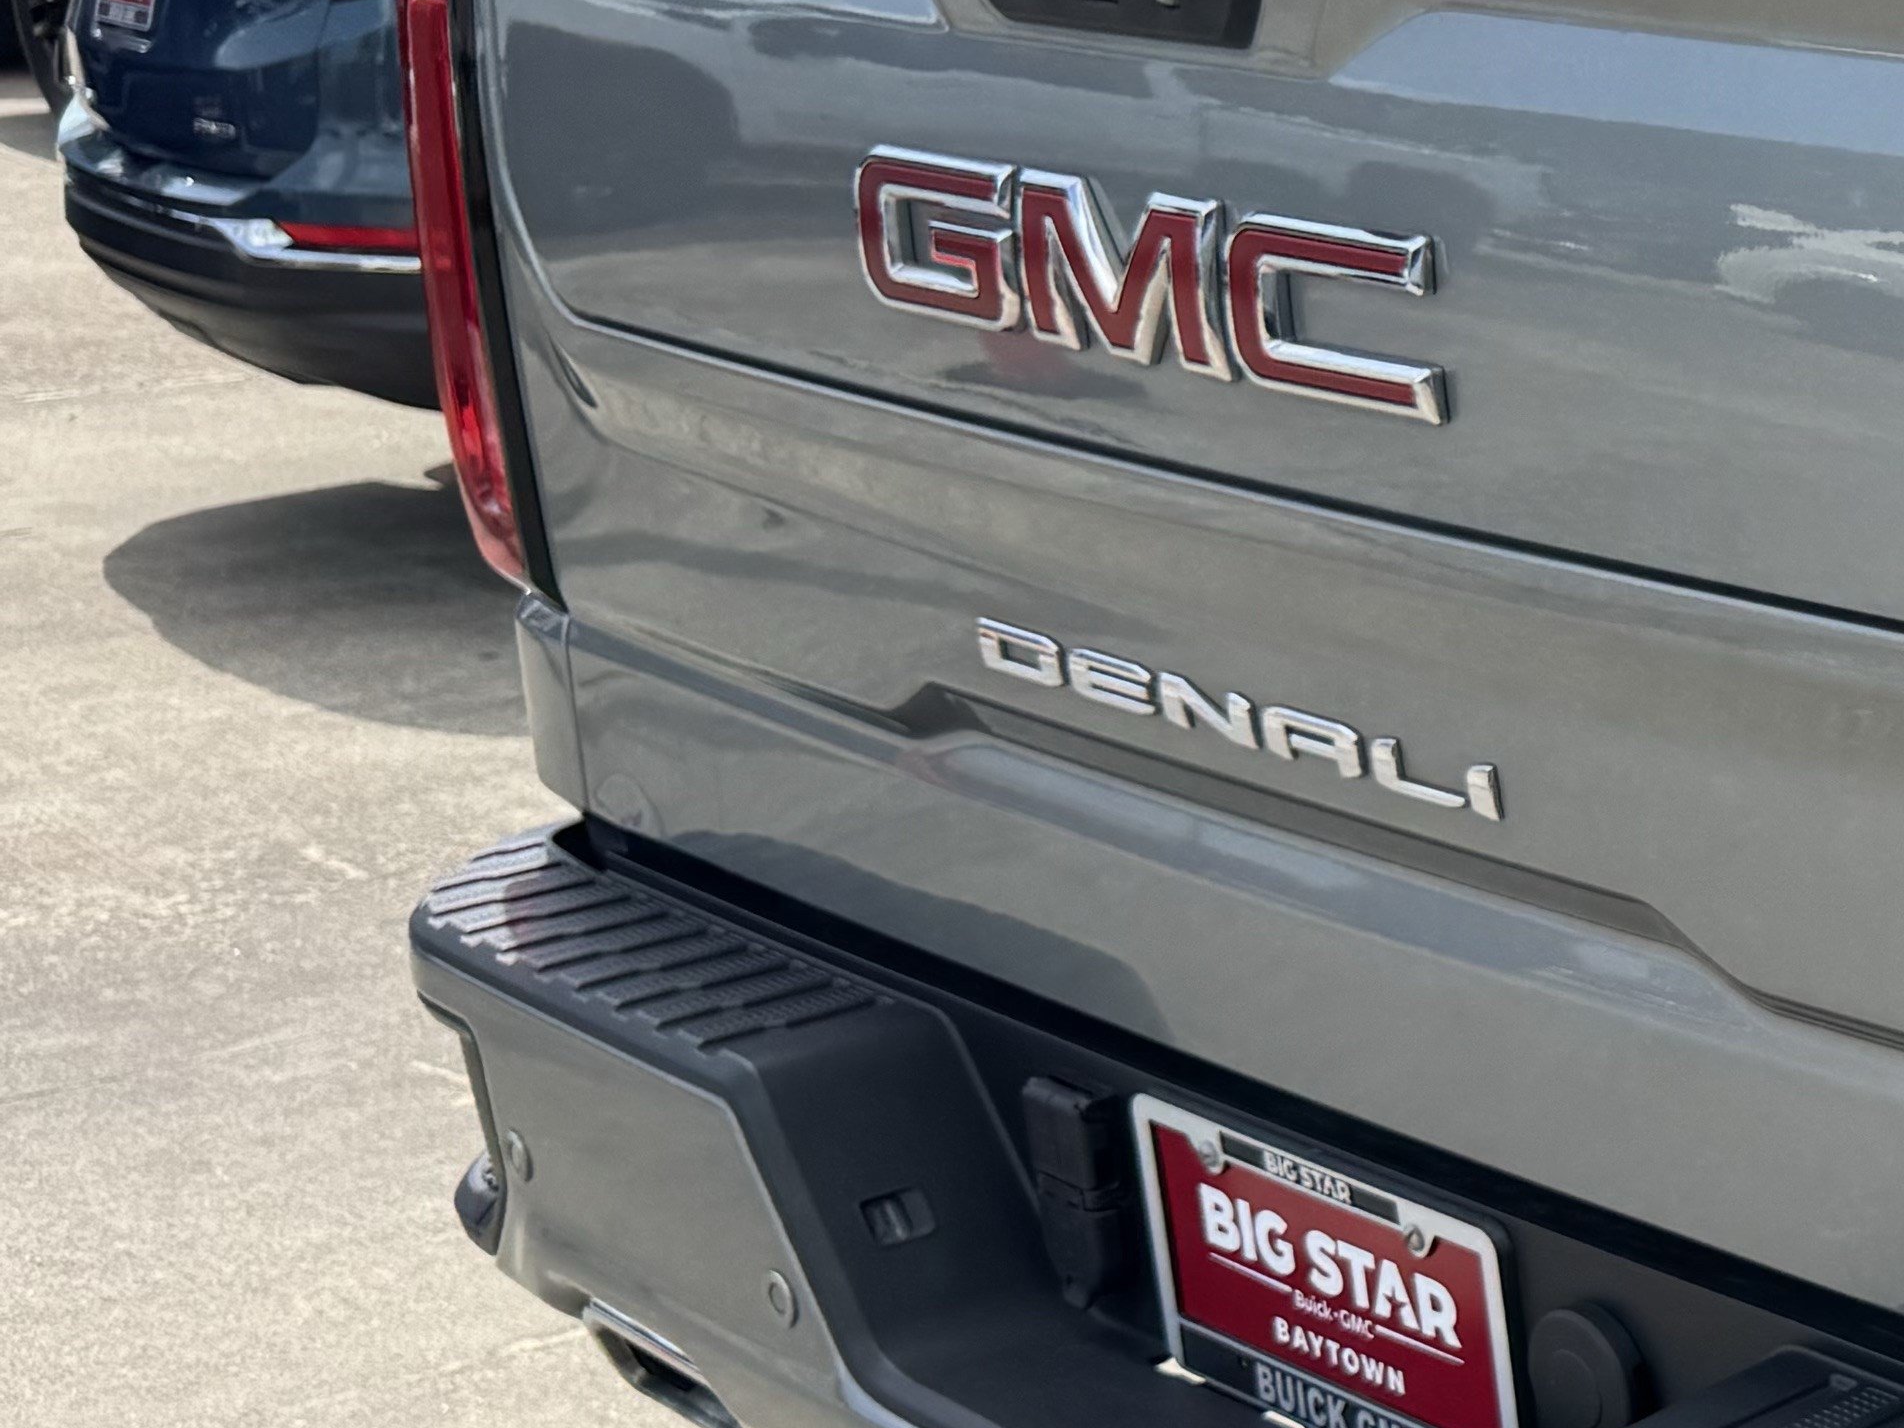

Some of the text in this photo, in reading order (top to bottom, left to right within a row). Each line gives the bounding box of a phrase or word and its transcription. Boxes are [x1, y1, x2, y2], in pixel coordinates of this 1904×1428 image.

[855, 143, 1451, 426] GMC
[977, 615, 1505, 822] DENALI
[1262, 1150, 1354, 1206] BIG STAR
[1198, 1182, 1463, 1349] BIG STAR
[1272, 1316, 1406, 1396] BAYTOWN
